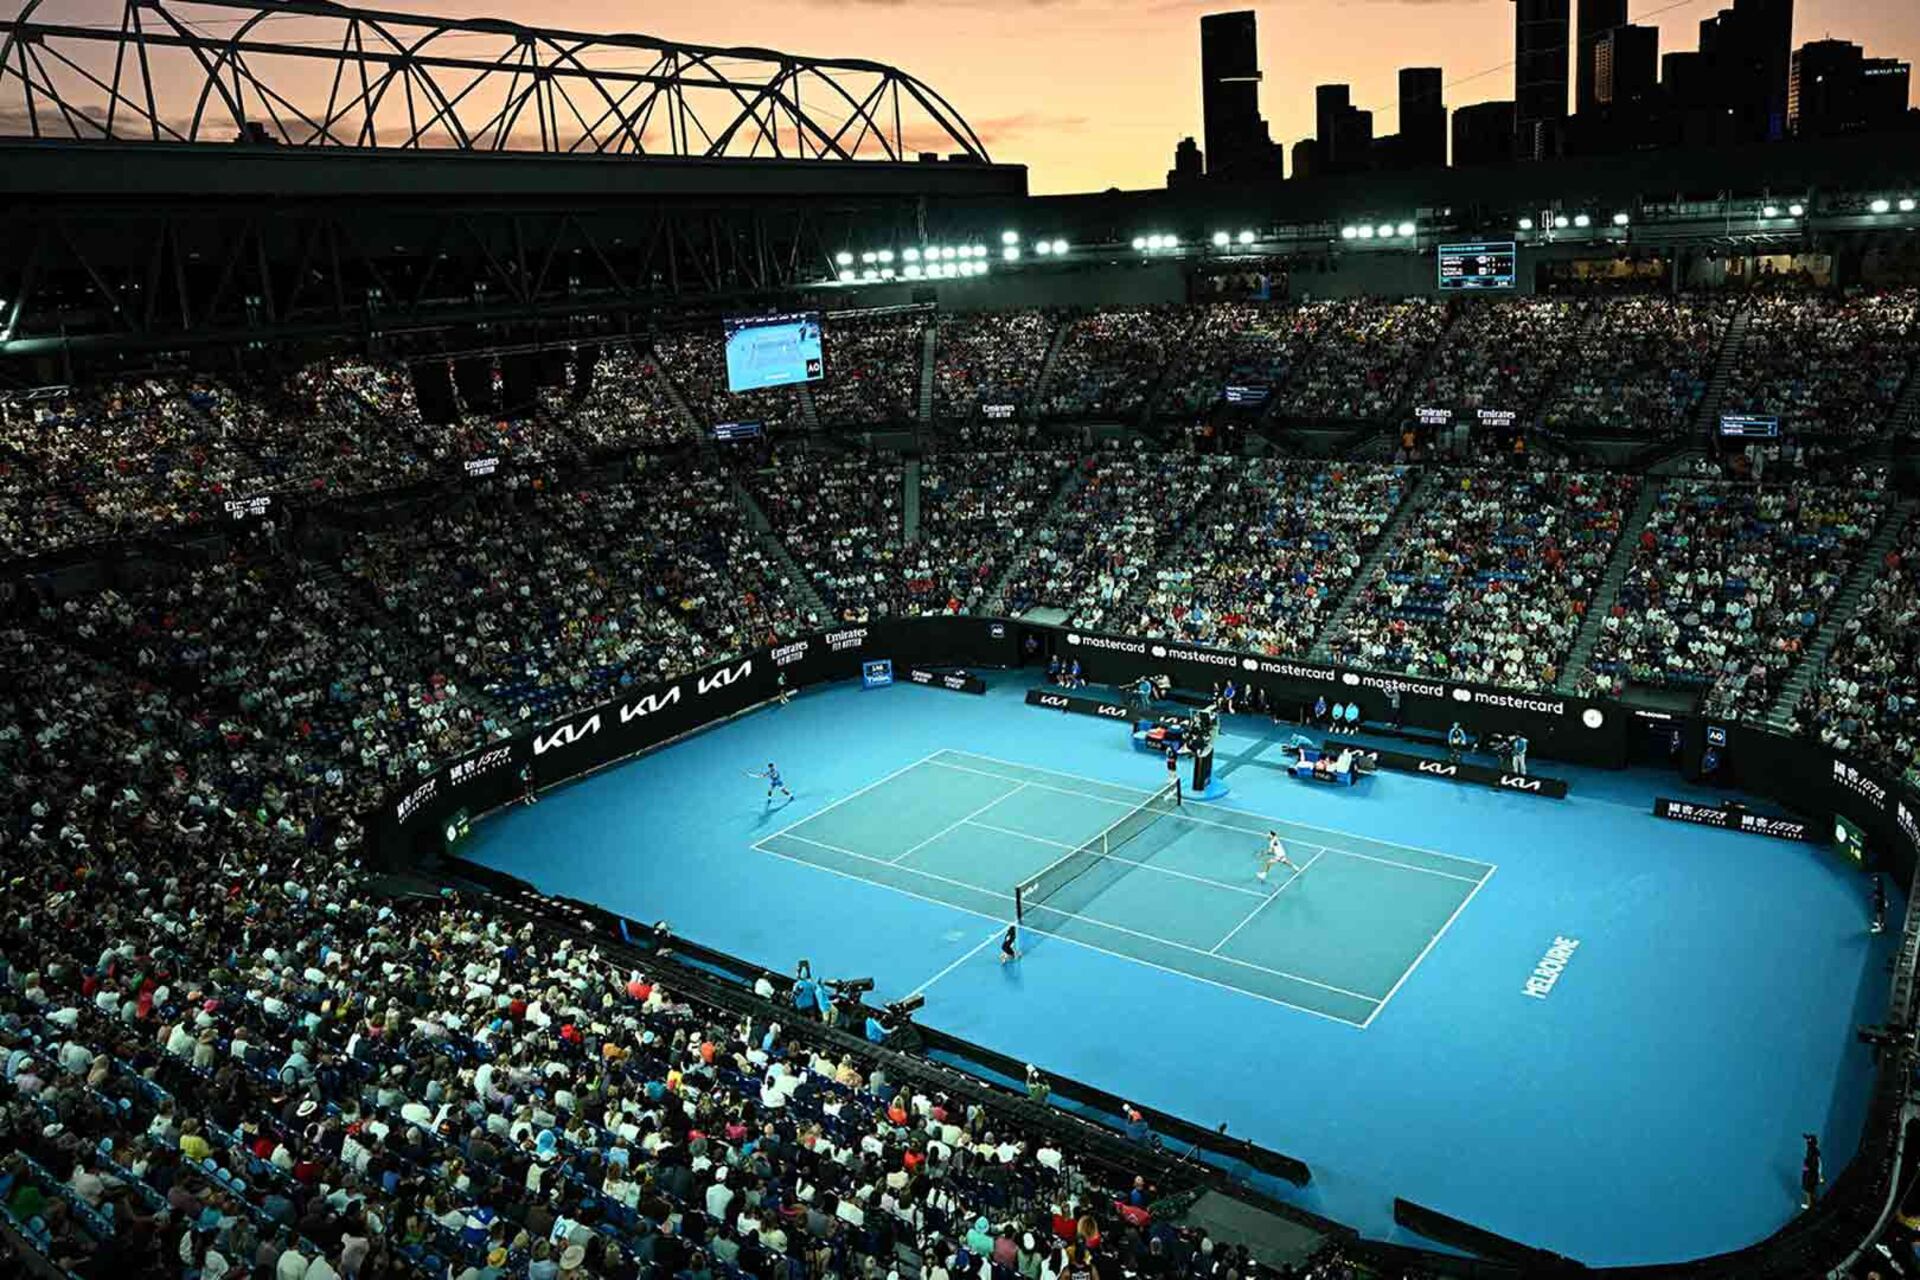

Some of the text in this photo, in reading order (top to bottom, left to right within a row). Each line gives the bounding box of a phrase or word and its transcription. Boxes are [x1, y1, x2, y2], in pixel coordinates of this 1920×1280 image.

[808, 361, 820, 373] AO
[1415, 407, 1452, 418] Emirates
[1477, 408, 1516, 419] Emirates
[825, 627, 868, 644] Emirates
[1083, 635, 1146, 654] mastercard
[771, 640, 809, 660] Emirates
[1168, 648, 1237, 667] mastercard
[698, 659, 751, 695] KIA
[1260, 660, 1336, 681] mastercard
[1362, 676, 1444, 698] mastercard
[620, 685, 681, 724] KIA
[1475, 691, 1564, 715] mastercard
[533, 713, 601, 756] KIA
[1709, 731, 1723, 742] AO
[1521, 935, 1580, 999] MELBOURNE
